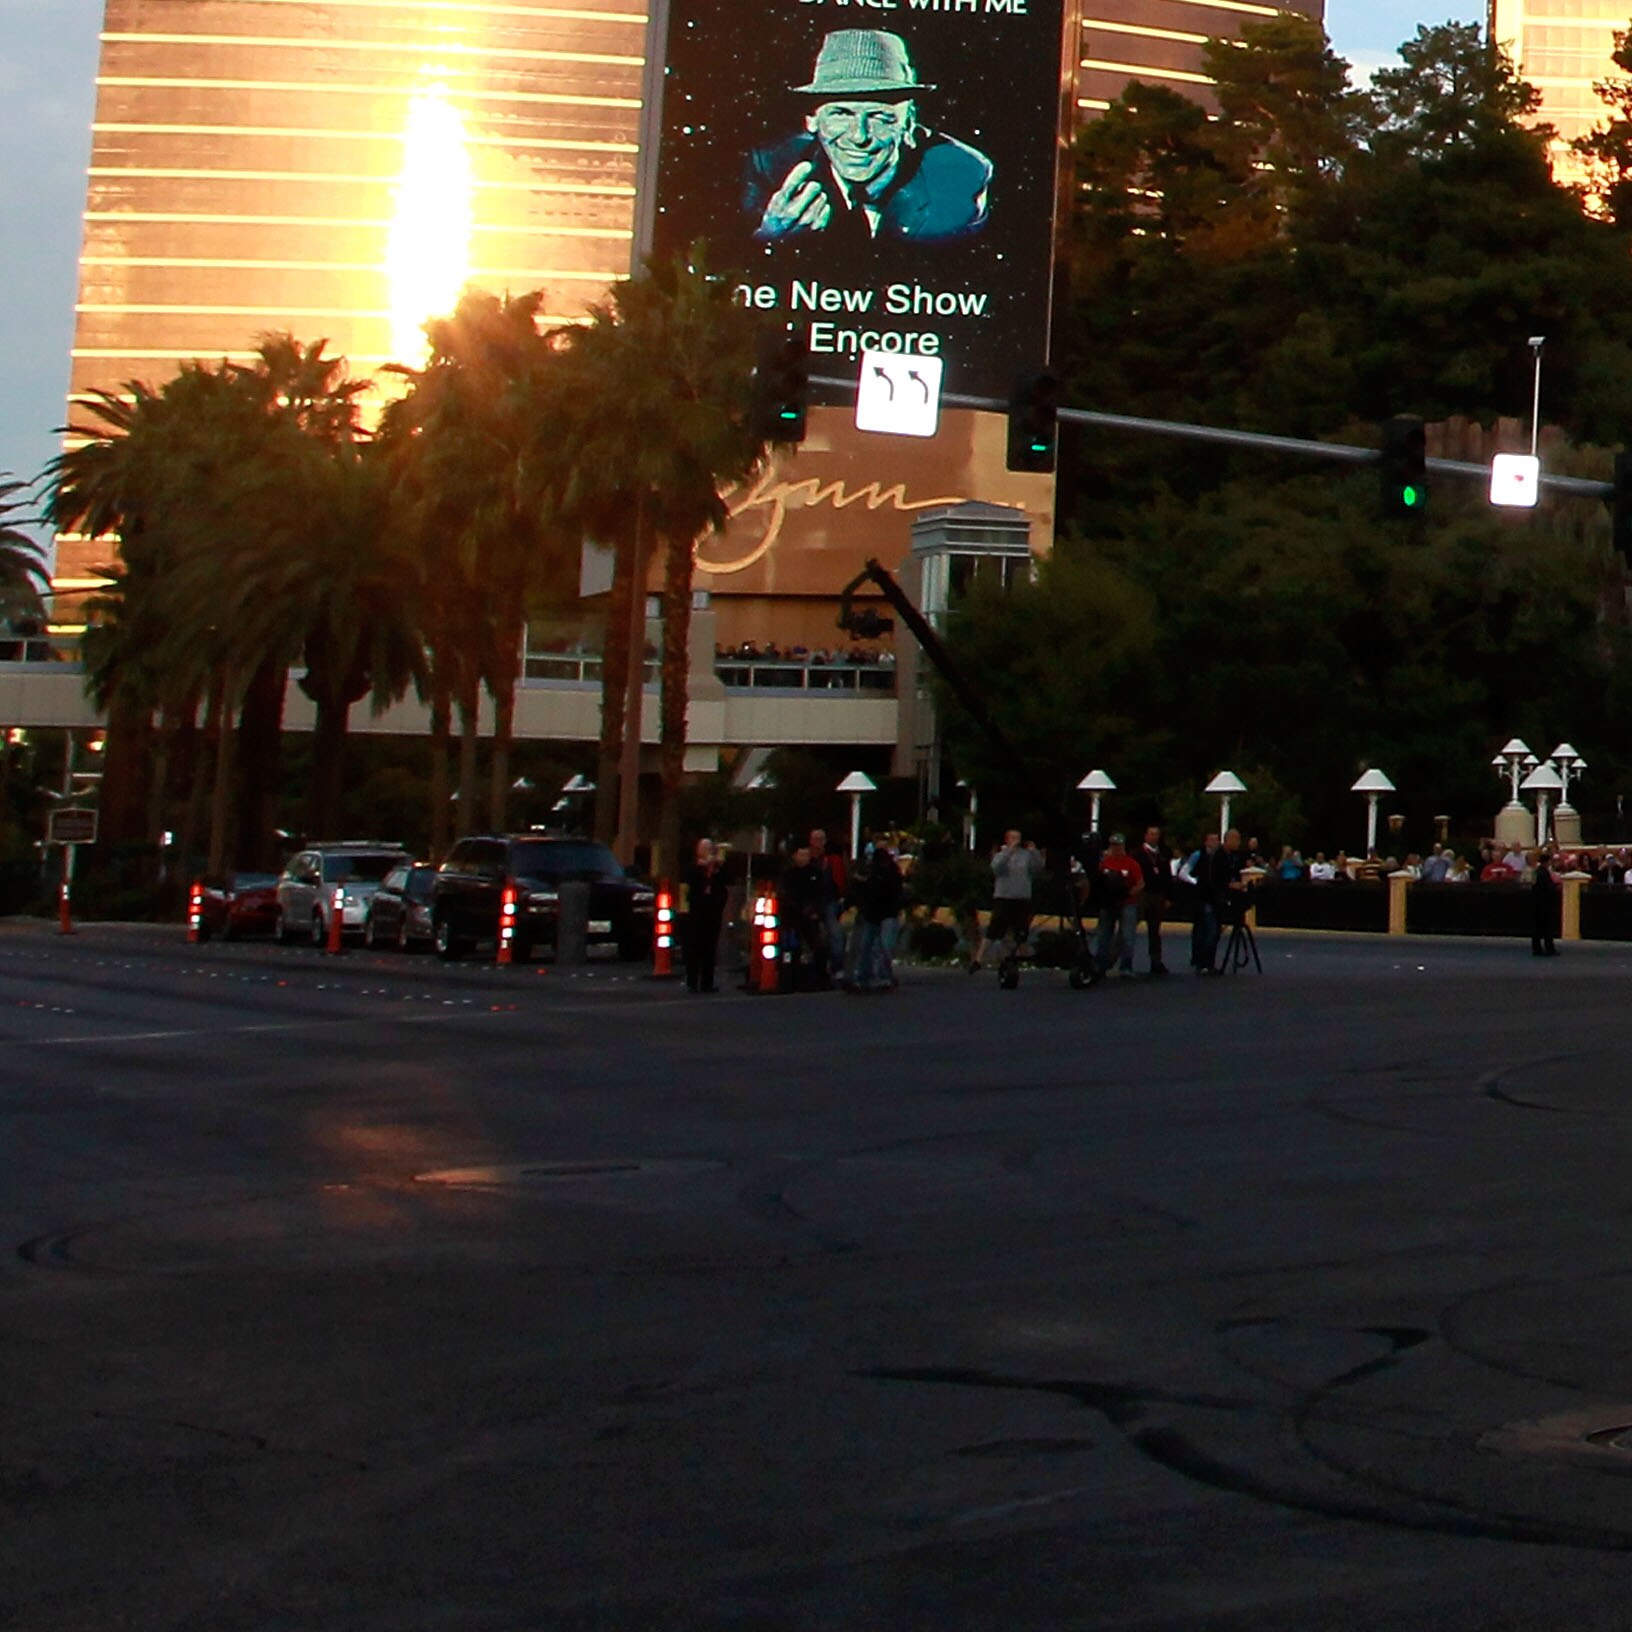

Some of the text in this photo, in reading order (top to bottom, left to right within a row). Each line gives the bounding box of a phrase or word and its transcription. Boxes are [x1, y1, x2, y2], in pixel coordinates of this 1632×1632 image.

[790, 282, 872, 315] New
[885, 285, 987, 317] Show
[809, 323, 940, 354] Encore
